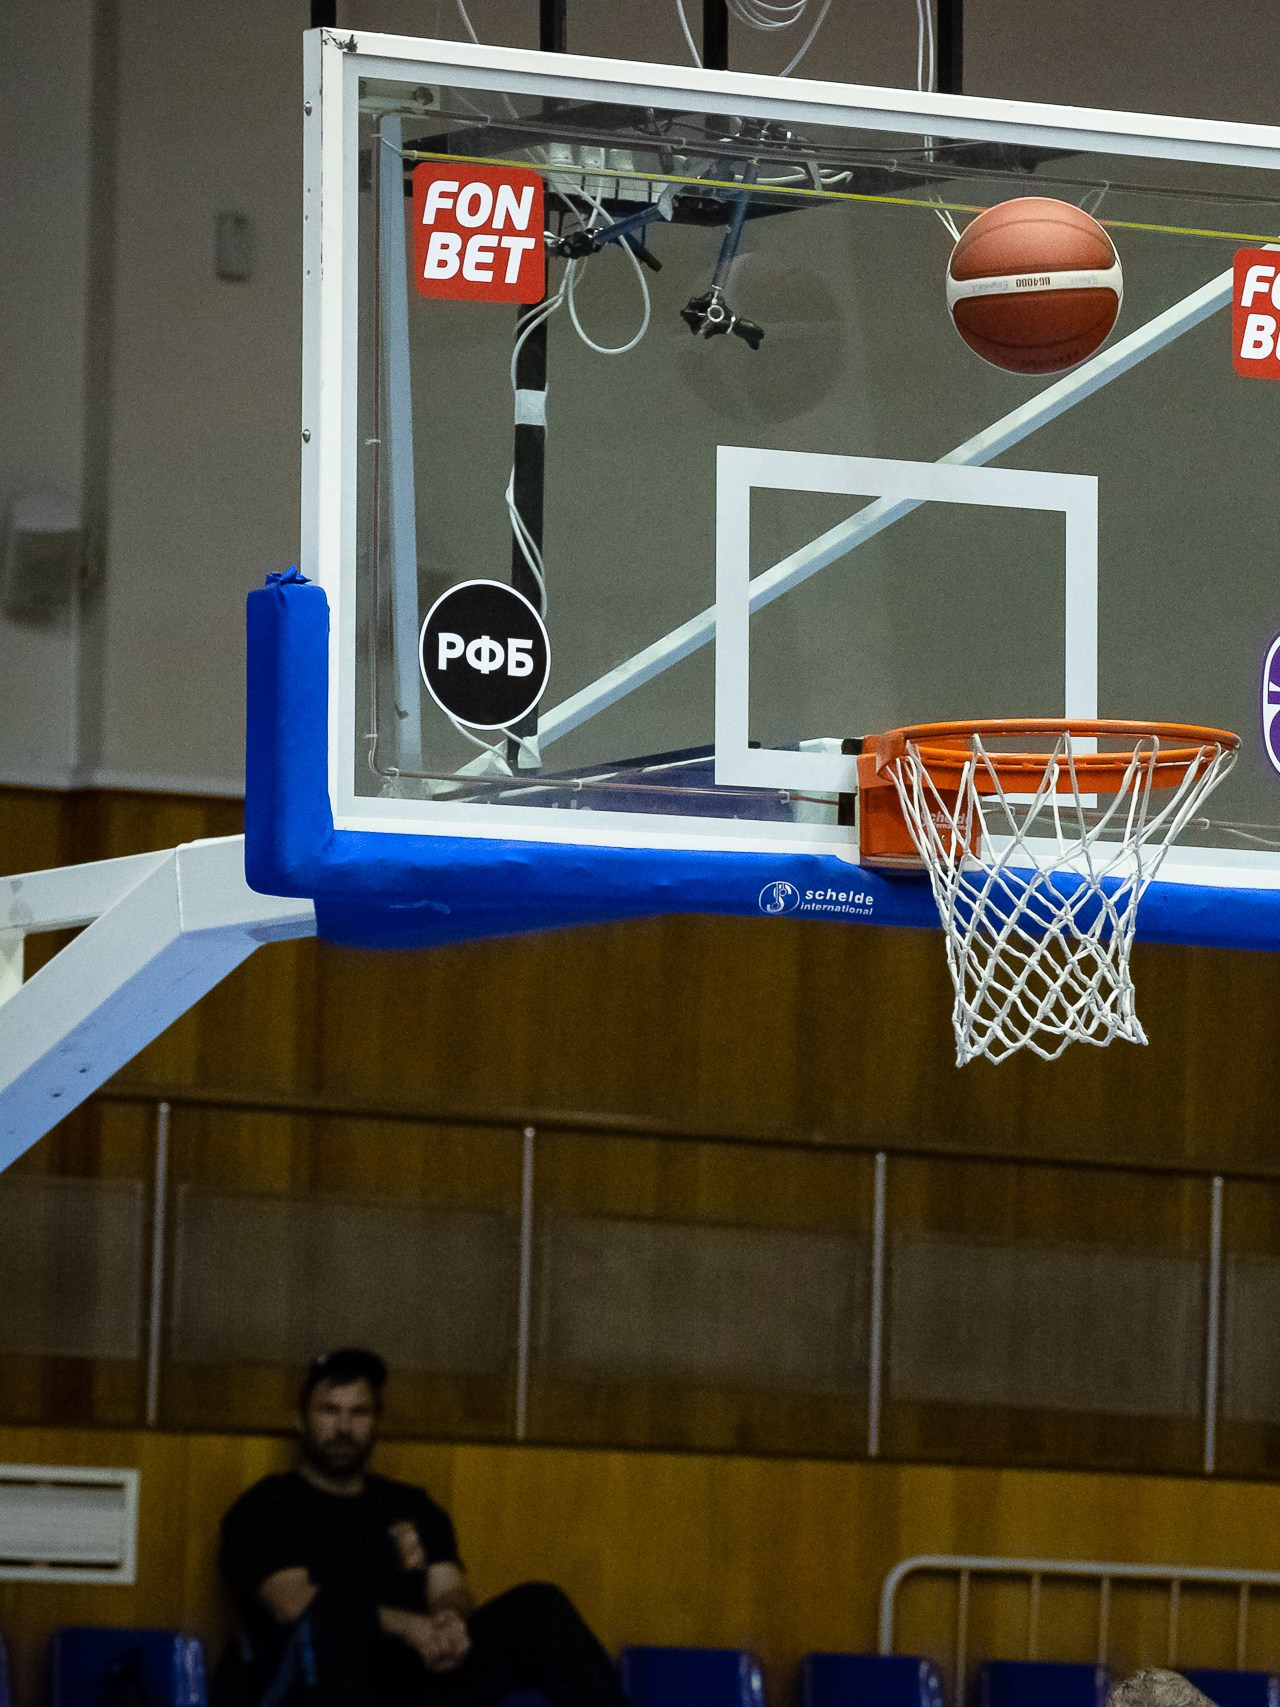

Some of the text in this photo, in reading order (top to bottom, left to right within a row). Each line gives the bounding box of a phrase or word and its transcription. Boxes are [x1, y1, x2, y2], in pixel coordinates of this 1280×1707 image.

[422, 180, 535, 231] FON
[423, 231, 536, 285] BET
[437, 632, 534, 678] РФБ
[800, 902, 873, 916] international
[805, 888, 874, 906] schelde
